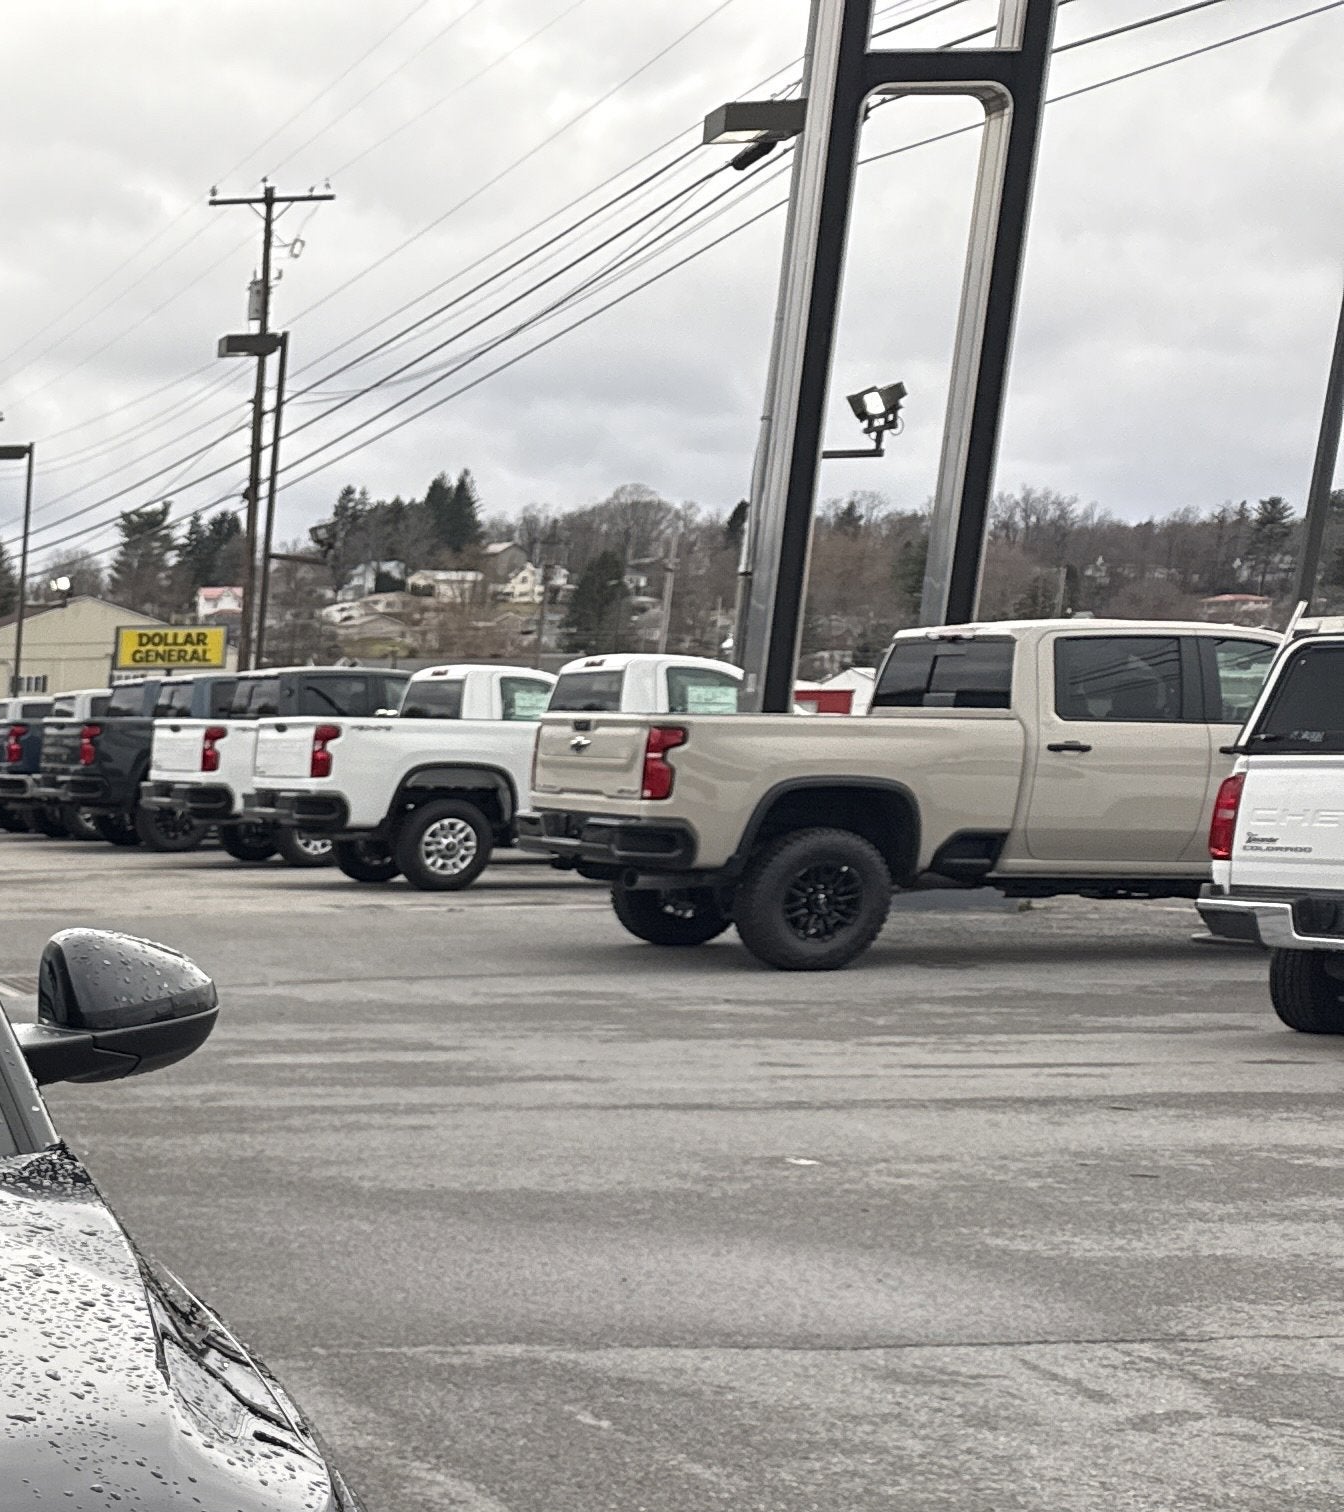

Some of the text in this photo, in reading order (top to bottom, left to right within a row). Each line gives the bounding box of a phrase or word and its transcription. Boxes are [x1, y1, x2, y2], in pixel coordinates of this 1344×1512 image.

[137, 632, 208, 647] DOLLAR
[132, 649, 211, 663] GENERAL
[1242, 844, 1313, 853] COLORADO
